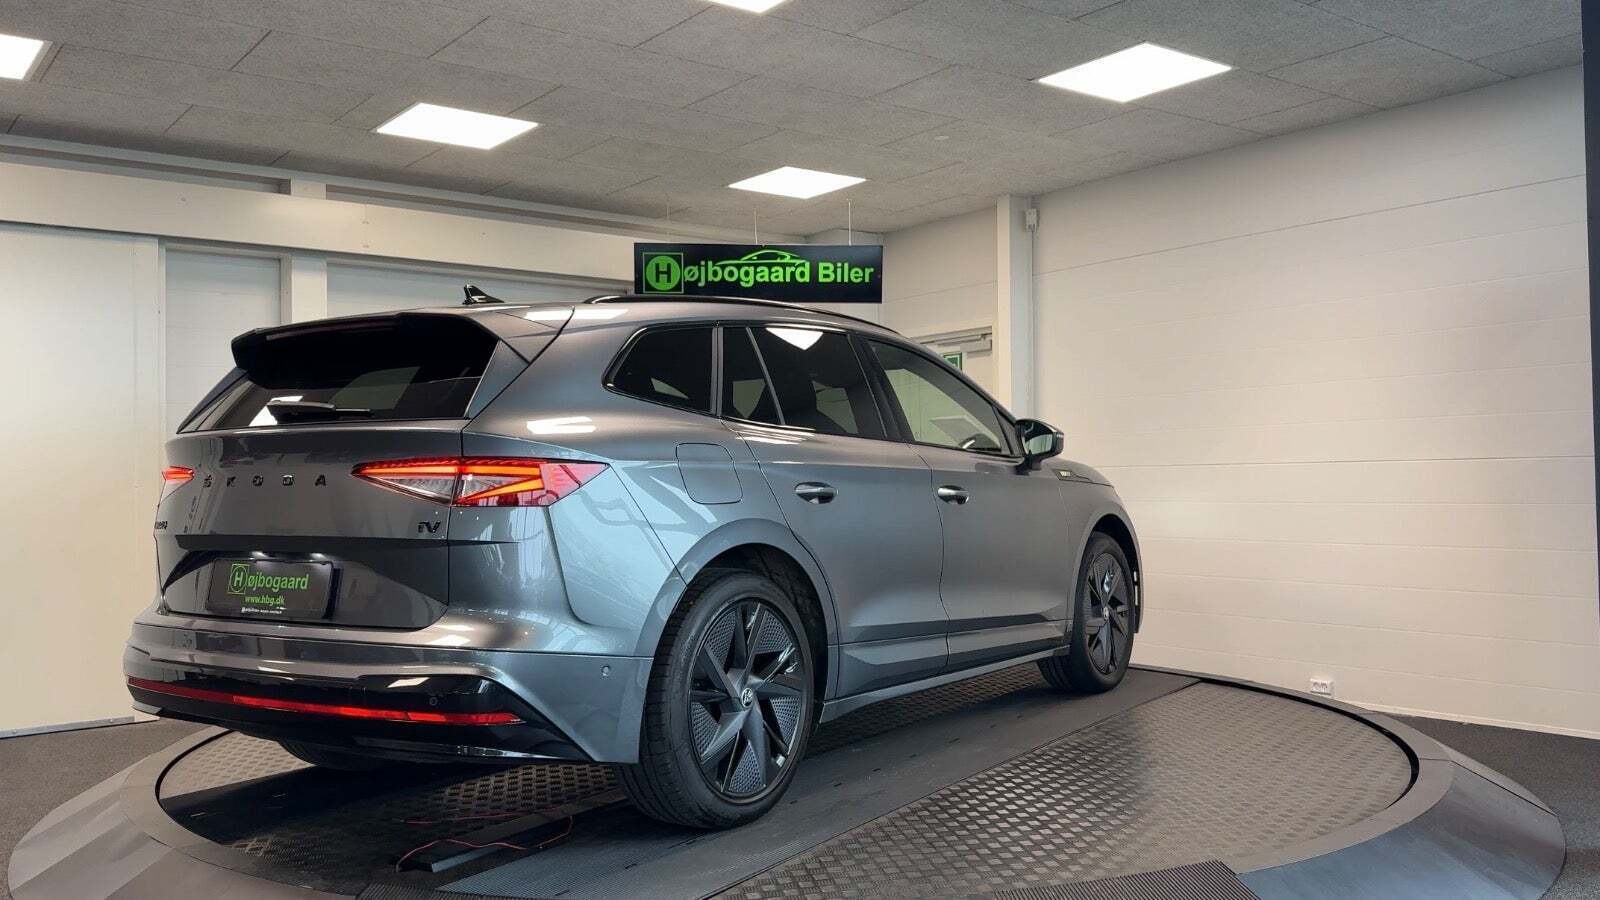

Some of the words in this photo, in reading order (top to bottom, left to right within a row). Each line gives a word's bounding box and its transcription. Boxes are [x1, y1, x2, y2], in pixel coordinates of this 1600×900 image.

[655, 261, 810, 287] Højbogaard
[818, 262, 874, 284] Biler
[233, 571, 310, 592] Højbogaard
[245, 594, 286, 606] www.hbg.dk
